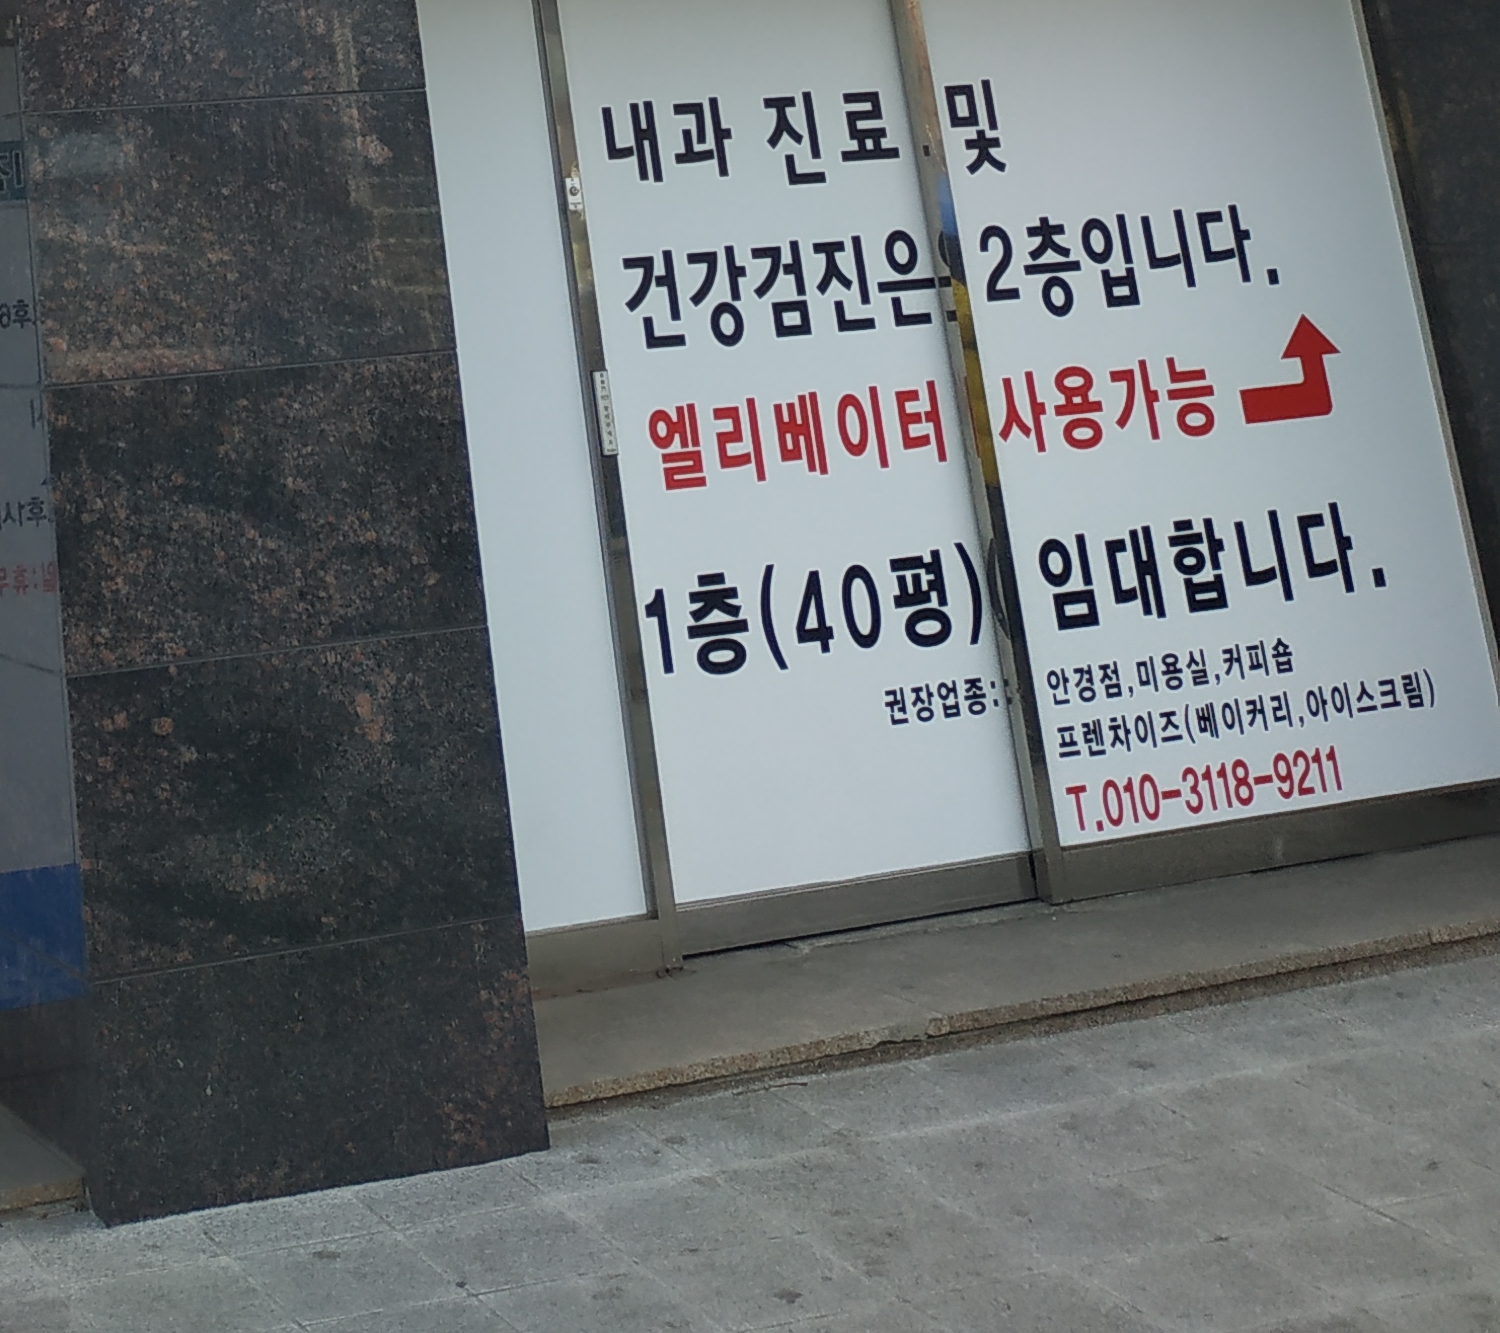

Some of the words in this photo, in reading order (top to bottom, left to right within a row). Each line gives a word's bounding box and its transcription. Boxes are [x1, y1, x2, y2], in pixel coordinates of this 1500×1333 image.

[602, 96, 732, 183] 내과
[762, 90, 900, 186] 진료
[944, 79, 1009, 175] 및
[622, 230, 940, 349] 건강검진은
[978, 204, 1280, 317] 2층입니다.
[647, 380, 948, 491] 엘리베이터
[998, 356, 1216, 454] 사용가능
[643, 542, 984, 676] 1층(40평)
[1038, 501, 1388, 632] 임대합니다.
[884, 676, 1001, 726] 권장업종:
[1046, 636, 1294, 707] 안경점,미용실,커피숍
[1057, 667, 1437, 760] 프렌차이즈(베이커리,아이스크림)
[1066, 745, 1344, 832] T.010-3118-9211
